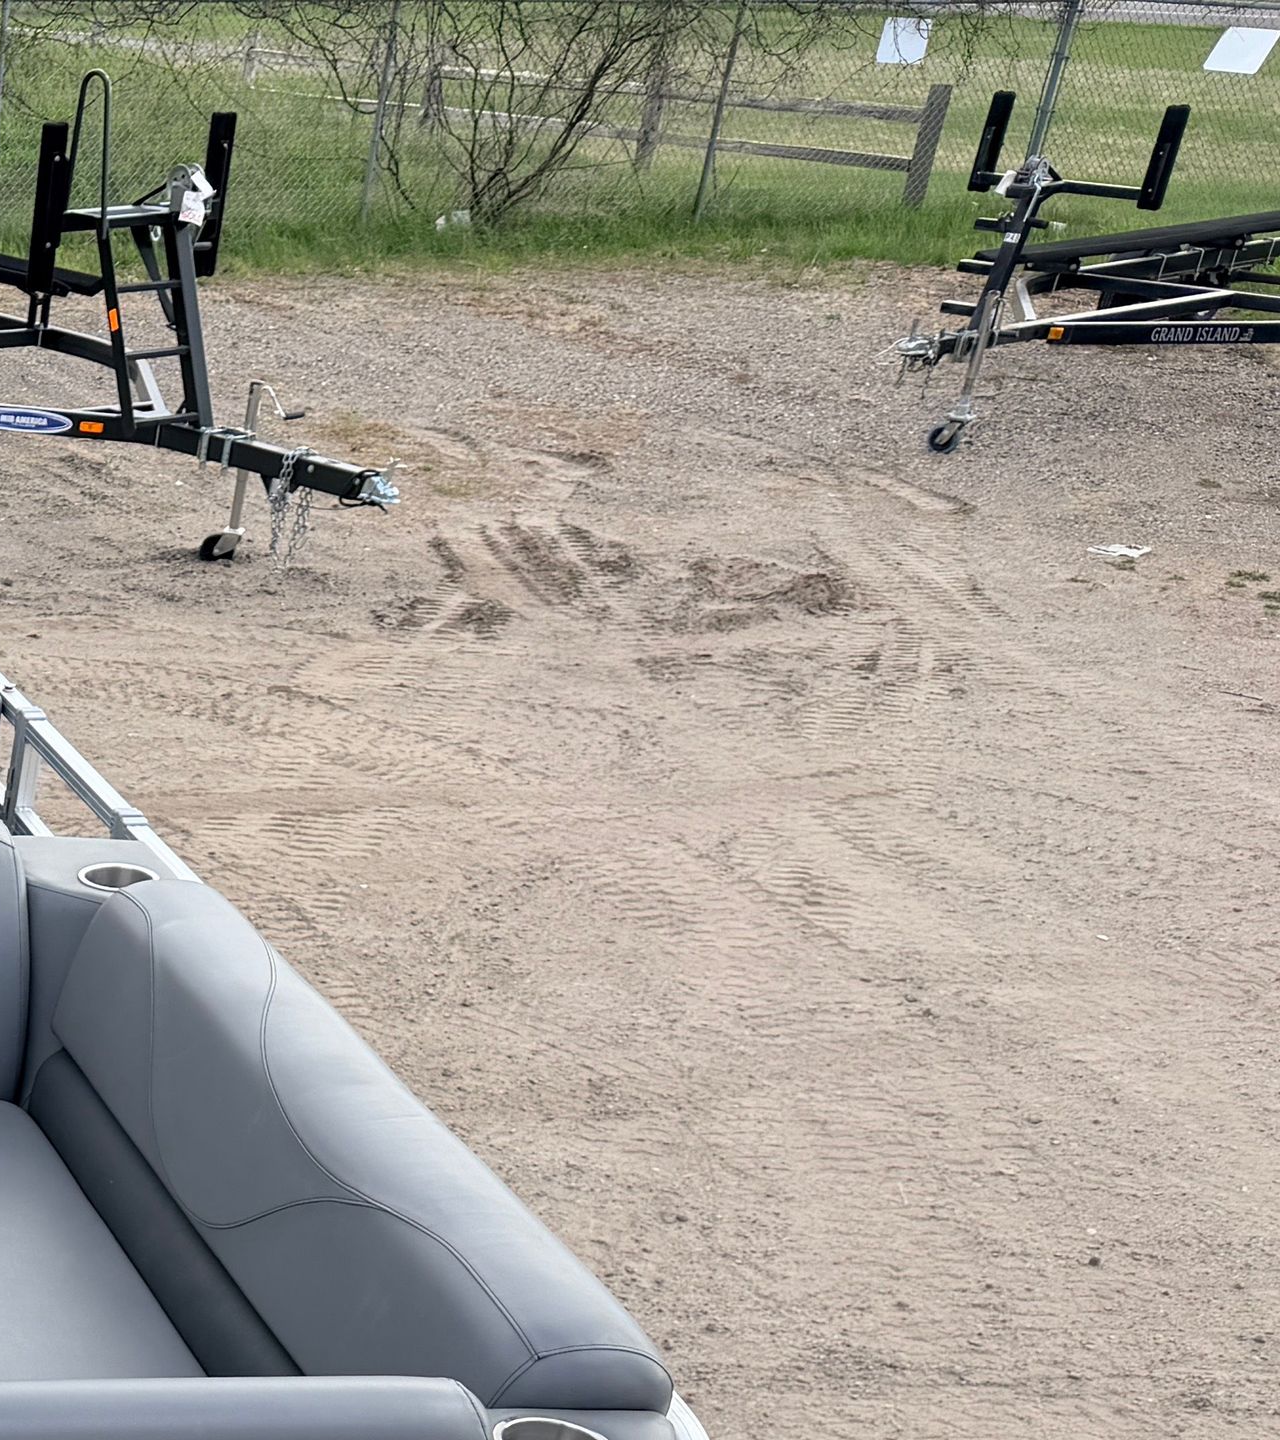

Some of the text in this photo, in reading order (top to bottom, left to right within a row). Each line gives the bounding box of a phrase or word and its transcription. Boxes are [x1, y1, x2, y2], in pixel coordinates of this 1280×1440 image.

[1150, 326, 1240, 342] GRAND ISLAND
[15, 415, 48, 426] AMERICA
